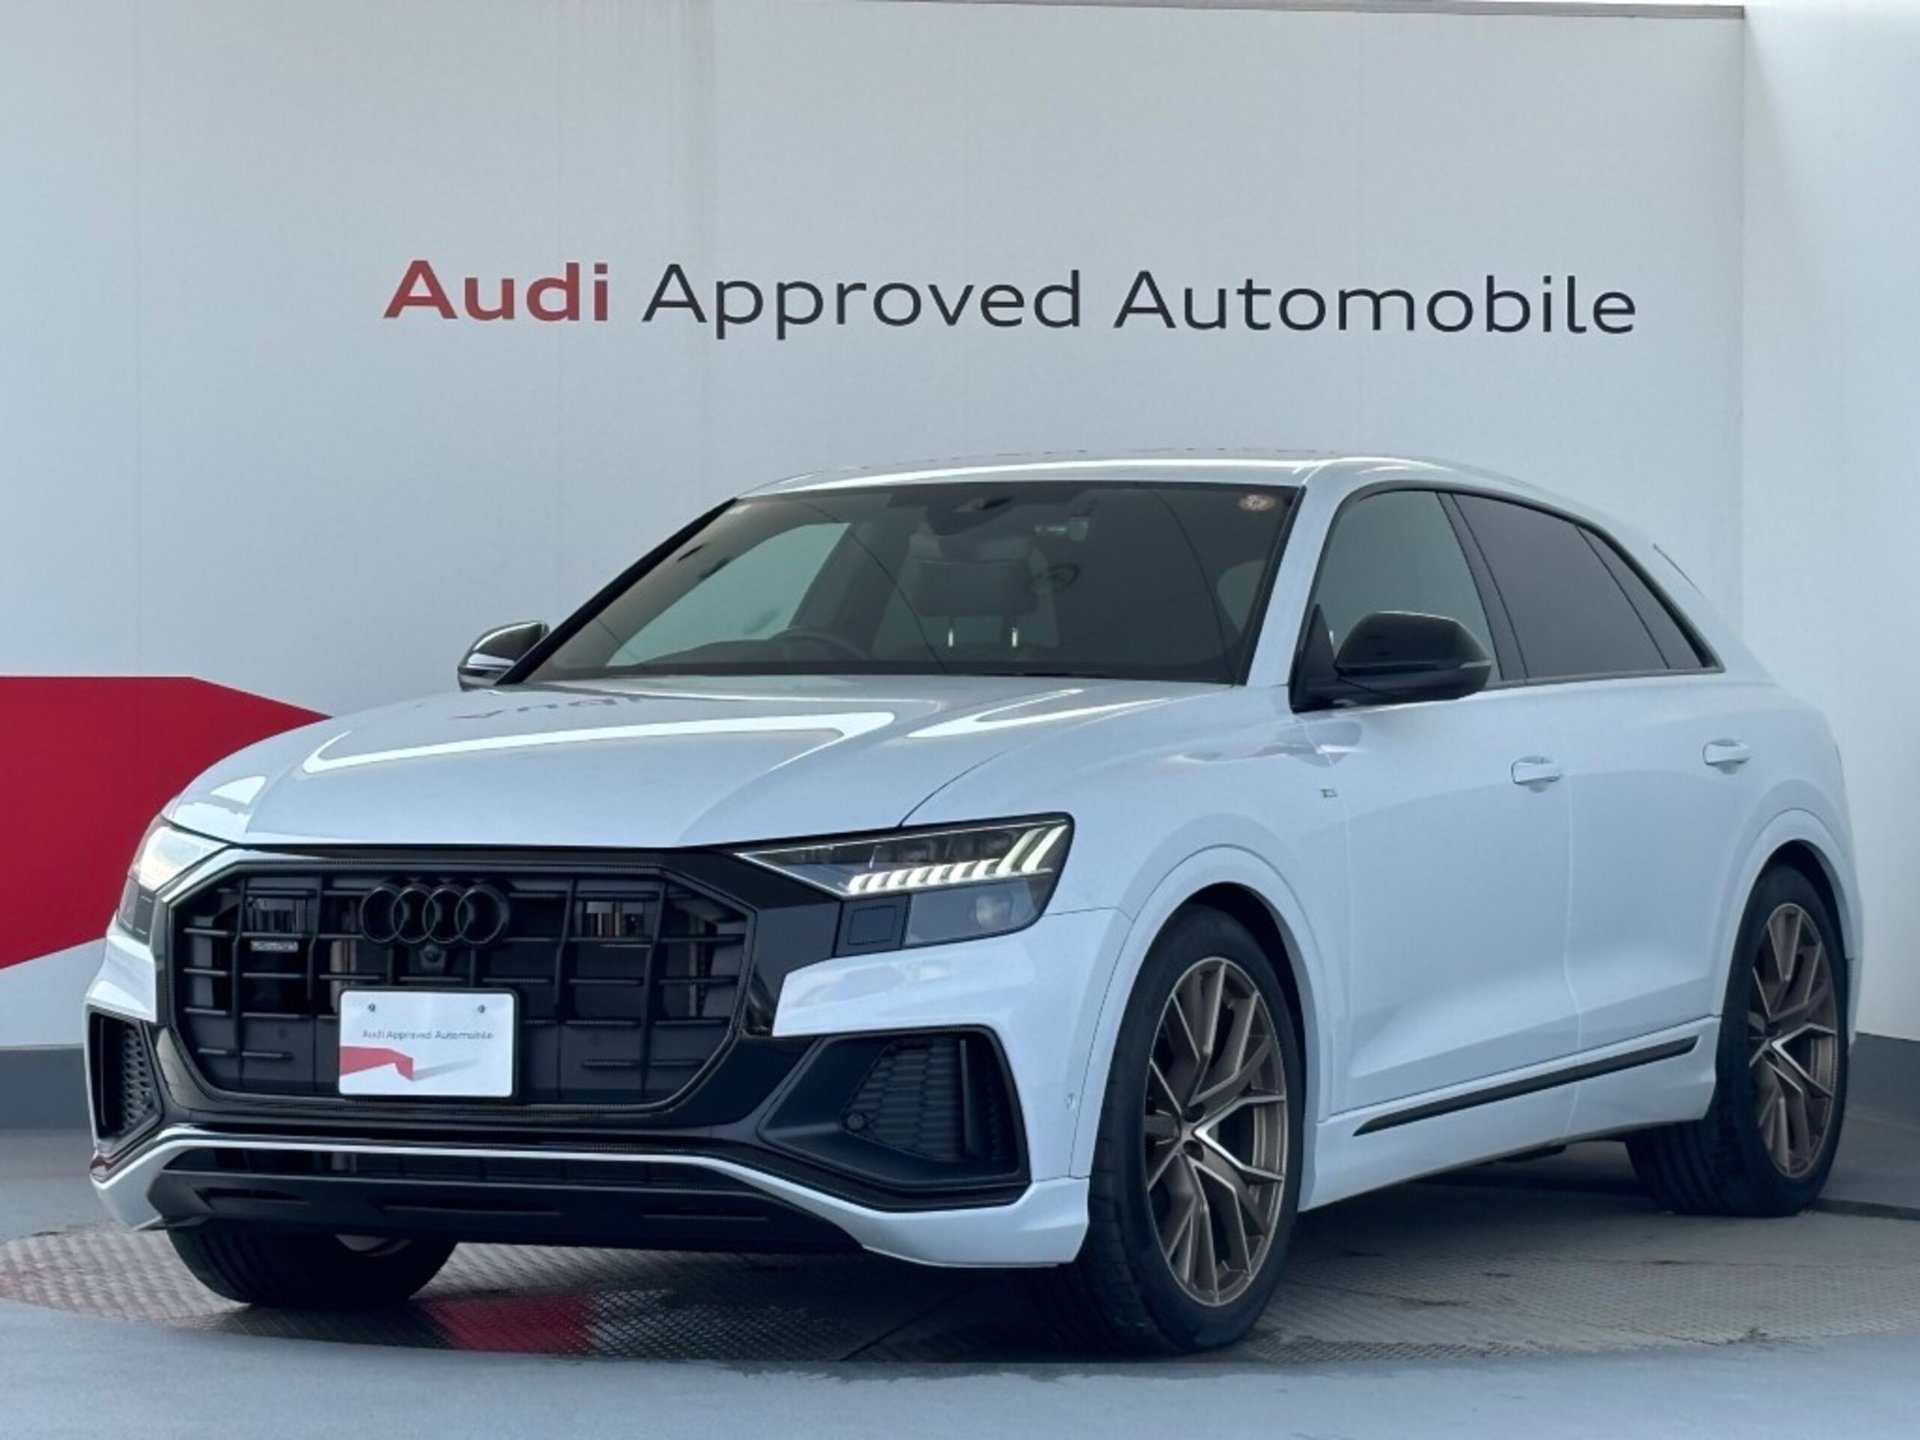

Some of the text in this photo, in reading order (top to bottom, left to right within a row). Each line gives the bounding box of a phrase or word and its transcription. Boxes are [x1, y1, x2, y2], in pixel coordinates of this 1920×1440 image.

[384, 260, 1636, 341] Audi Approved Automobile
[386, 1030, 432, 1041] Approved
[434, 1030, 494, 1040] Automobile
